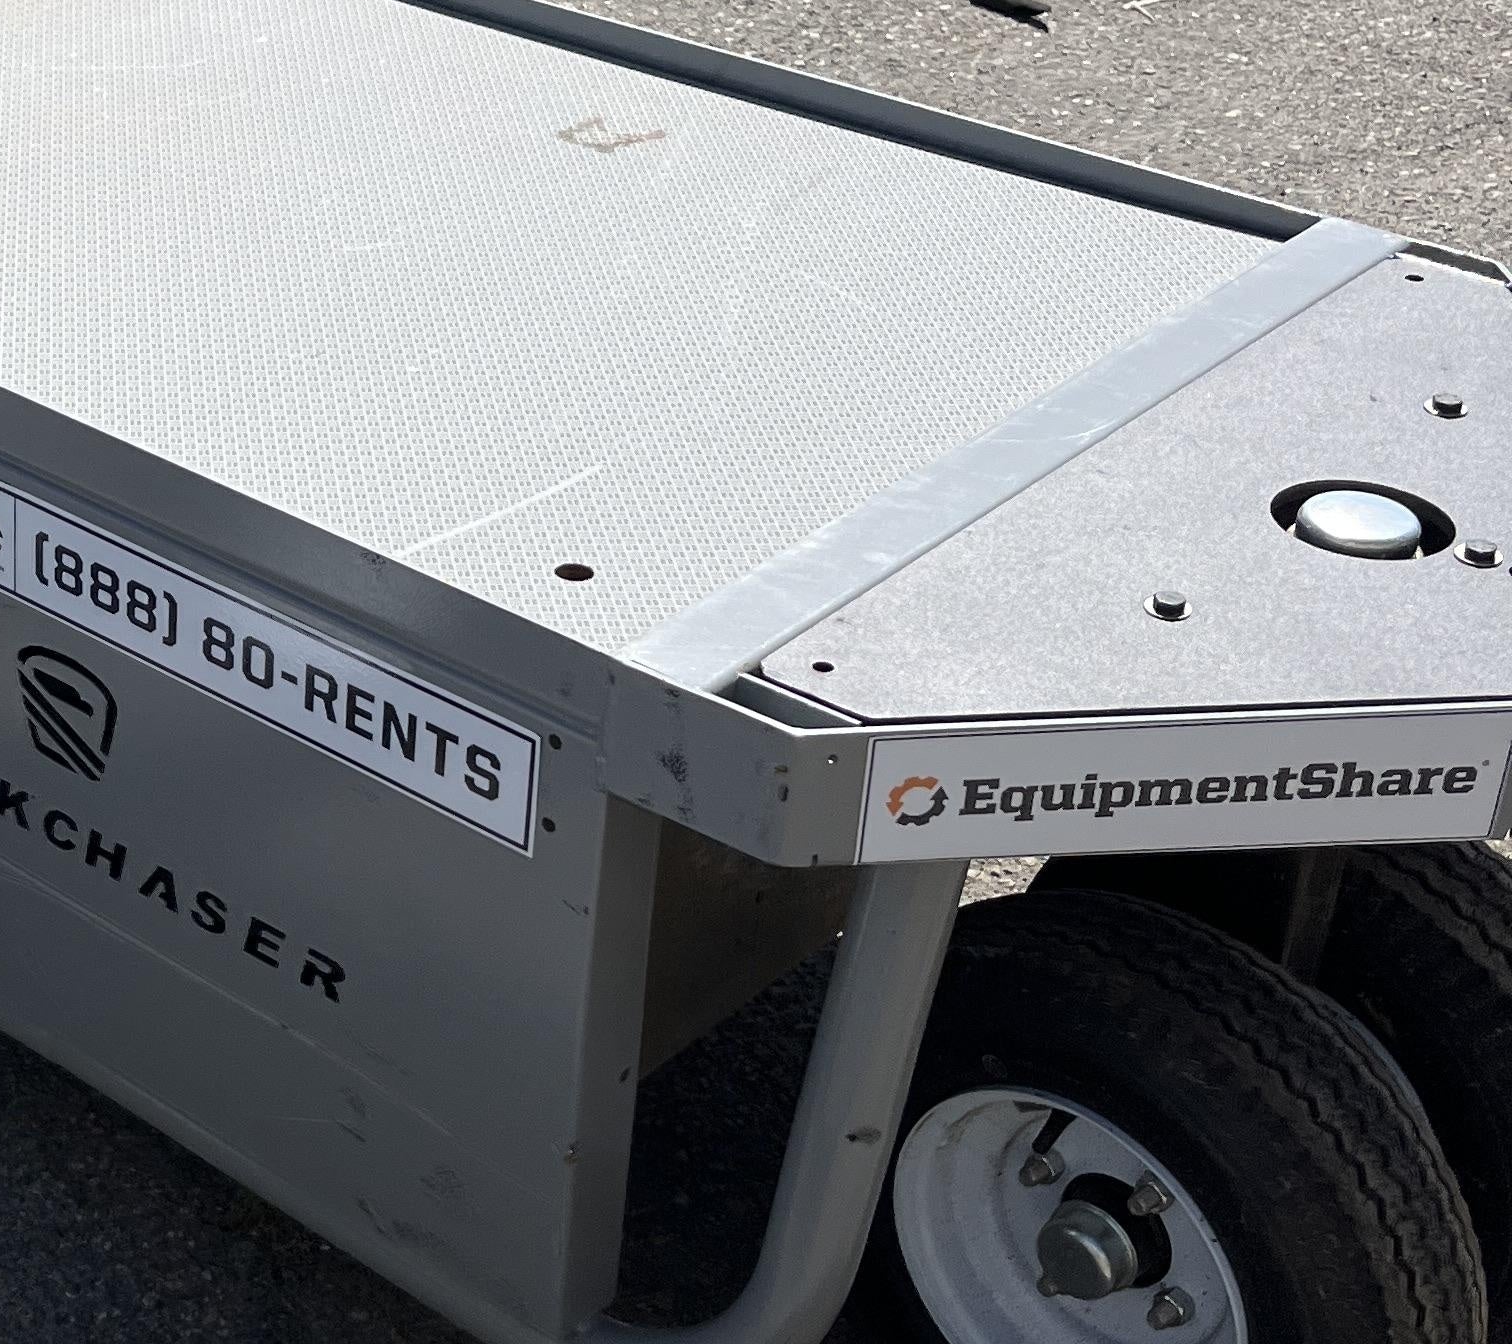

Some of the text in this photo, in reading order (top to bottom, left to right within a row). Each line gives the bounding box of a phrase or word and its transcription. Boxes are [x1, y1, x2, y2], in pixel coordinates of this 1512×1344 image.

[35, 531, 501, 802] (888) 80-RENTS
[958, 761, 1478, 822] EquipmentShare
